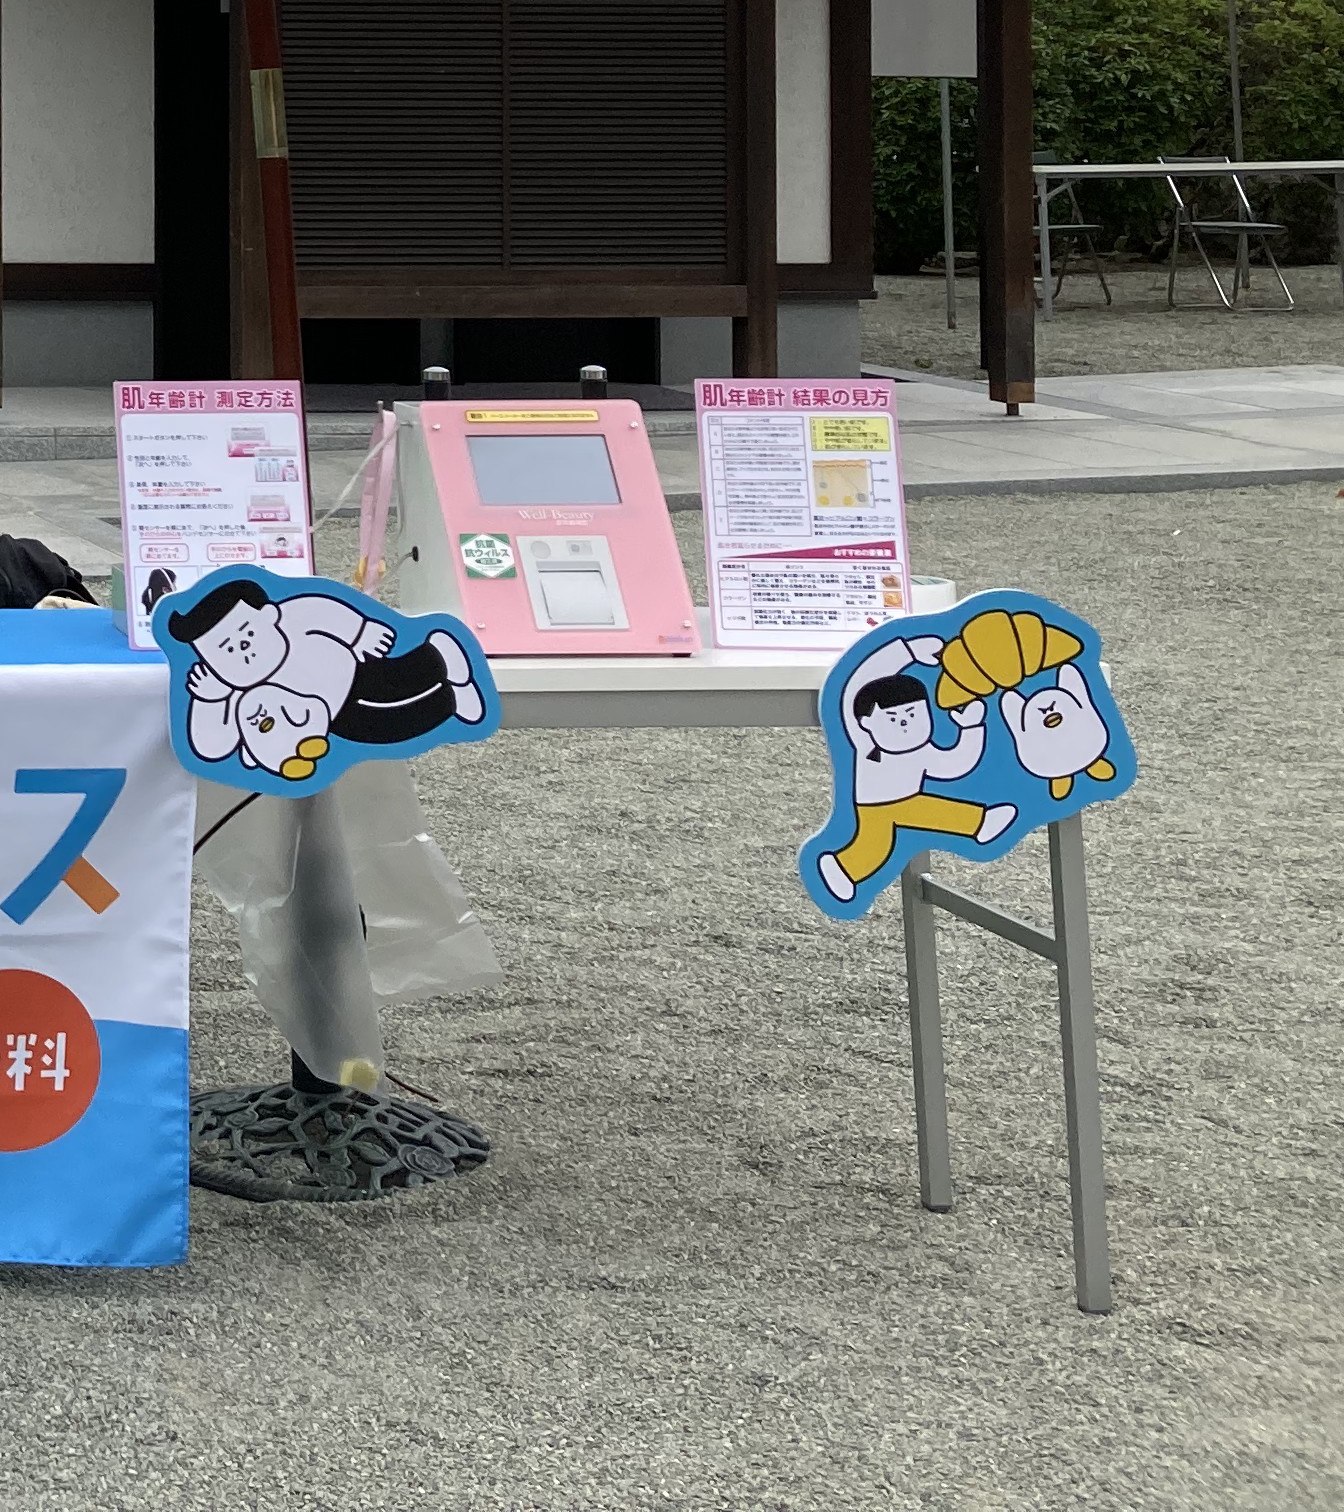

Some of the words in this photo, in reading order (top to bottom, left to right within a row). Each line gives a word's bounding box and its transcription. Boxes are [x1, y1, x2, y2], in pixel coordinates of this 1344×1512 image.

[121, 385, 206, 410] 肌年齢計
[216, 390, 295, 409] 測定方法
[702, 383, 785, 407] 肌年齢計
[793, 388, 889, 407] 結果の見方
[464, 549, 510, 558] 抗ウィルス
